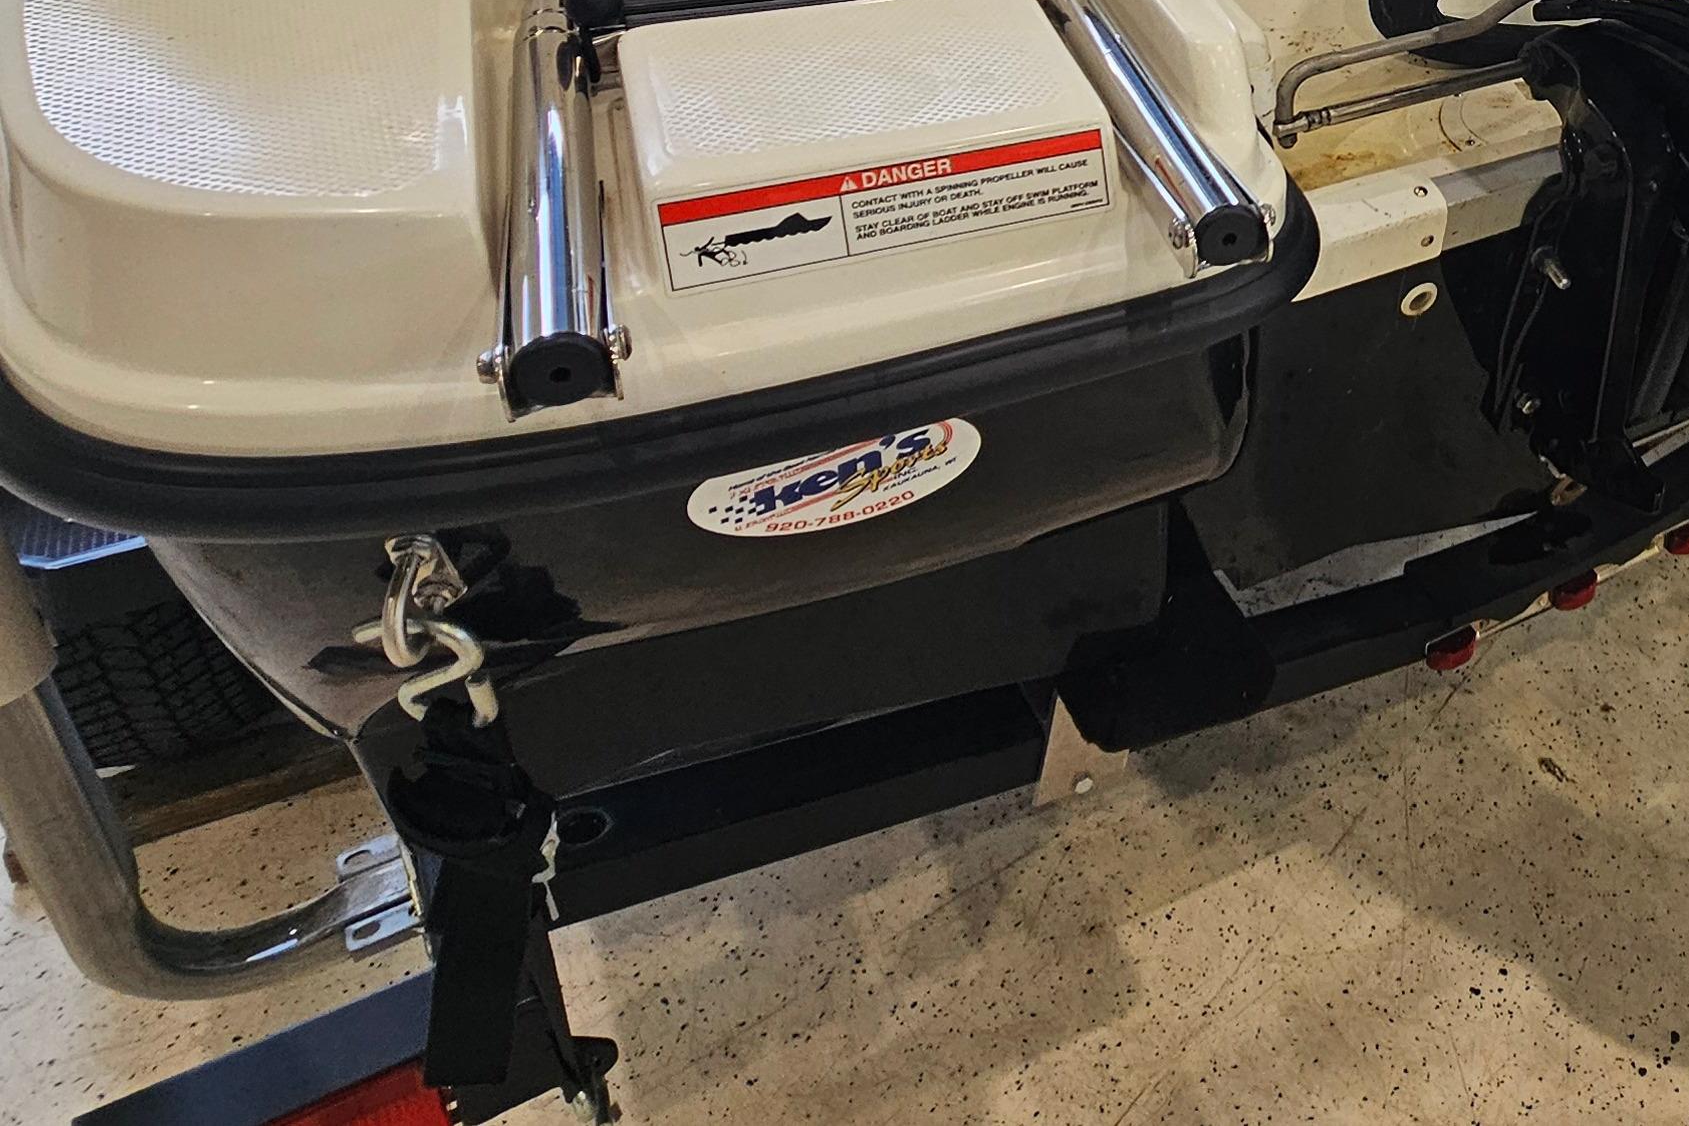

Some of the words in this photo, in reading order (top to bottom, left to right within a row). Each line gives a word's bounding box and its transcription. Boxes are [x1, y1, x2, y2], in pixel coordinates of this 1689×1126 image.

[850, 193, 898, 210] CONTACT
[899, 188, 924, 201] WITH
[925, 187, 933, 196] A
[934, 178, 979, 194] SPINNING
[979, 168, 1034, 186] PROPELLER
[1035, 164, 1057, 176] WILL
[1057, 158, 1088, 171] CAUSE
[861, 158, 952, 188] DANGER
[852, 203, 896, 219] SERIOUS
[897, 197, 931, 211] INJURY
[932, 194, 948, 204] OR
[949, 187, 983, 201] DEATH.
[854, 220, 880, 233] STAY
[880, 214, 915, 228] CLEAR
[916, 211, 930, 221] OF
[931, 206, 958, 218] BOAT
[959, 202, 980, 213] AND
[981, 197, 1006, 209] STAY
[1006, 193, 1025, 204] OFF
[1025, 188, 1051, 201] SWIM
[1051, 180, 1098, 196] PLATFORM
[855, 229, 877, 240] AND
[878, 219, 930, 236] BOARDING
[931, 211, 970, 226] LADDER
[971, 205, 1001, 219] WHILE
[1001, 199, 1035, 213] ENGINE
[1036, 197, 1046, 206] IS
[830, 441, 948, 512] Sports
[764, 490, 915, 533] 920-788-0220
